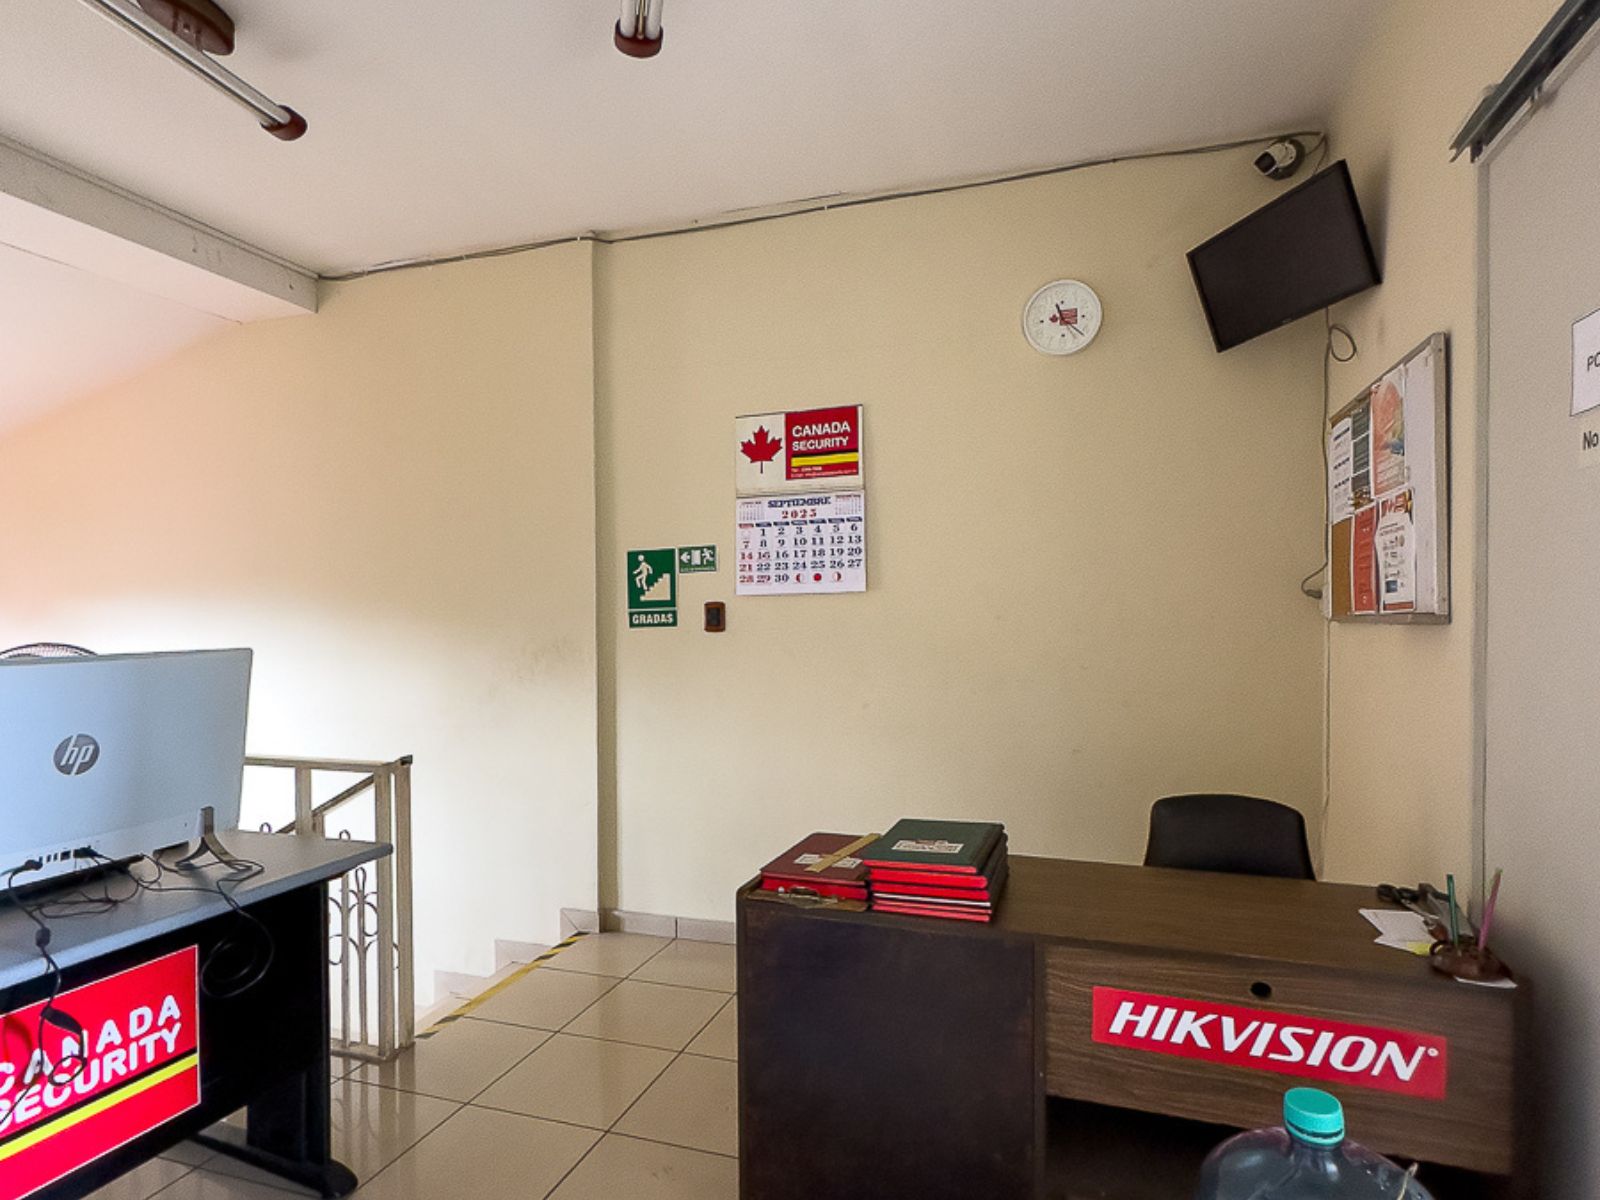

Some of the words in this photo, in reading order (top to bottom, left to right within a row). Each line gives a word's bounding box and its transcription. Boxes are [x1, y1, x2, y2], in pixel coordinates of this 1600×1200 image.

[792, 420, 851, 437] CANADA
[792, 436, 849, 451] SECURITY
[1583, 430, 1599, 450] No
[768, 497, 831, 507] SEPTIEMBRE
[782, 509, 816, 518] 2025
[812, 549, 825, 557] 18
[848, 547, 862, 555] 20
[740, 564, 752, 572] 21
[775, 562, 788, 570] 23
[848, 559, 862, 567] 27
[775, 574, 789, 582] 30
[632, 613, 673, 624] GRADAS
[60, 734, 94, 775] hp
